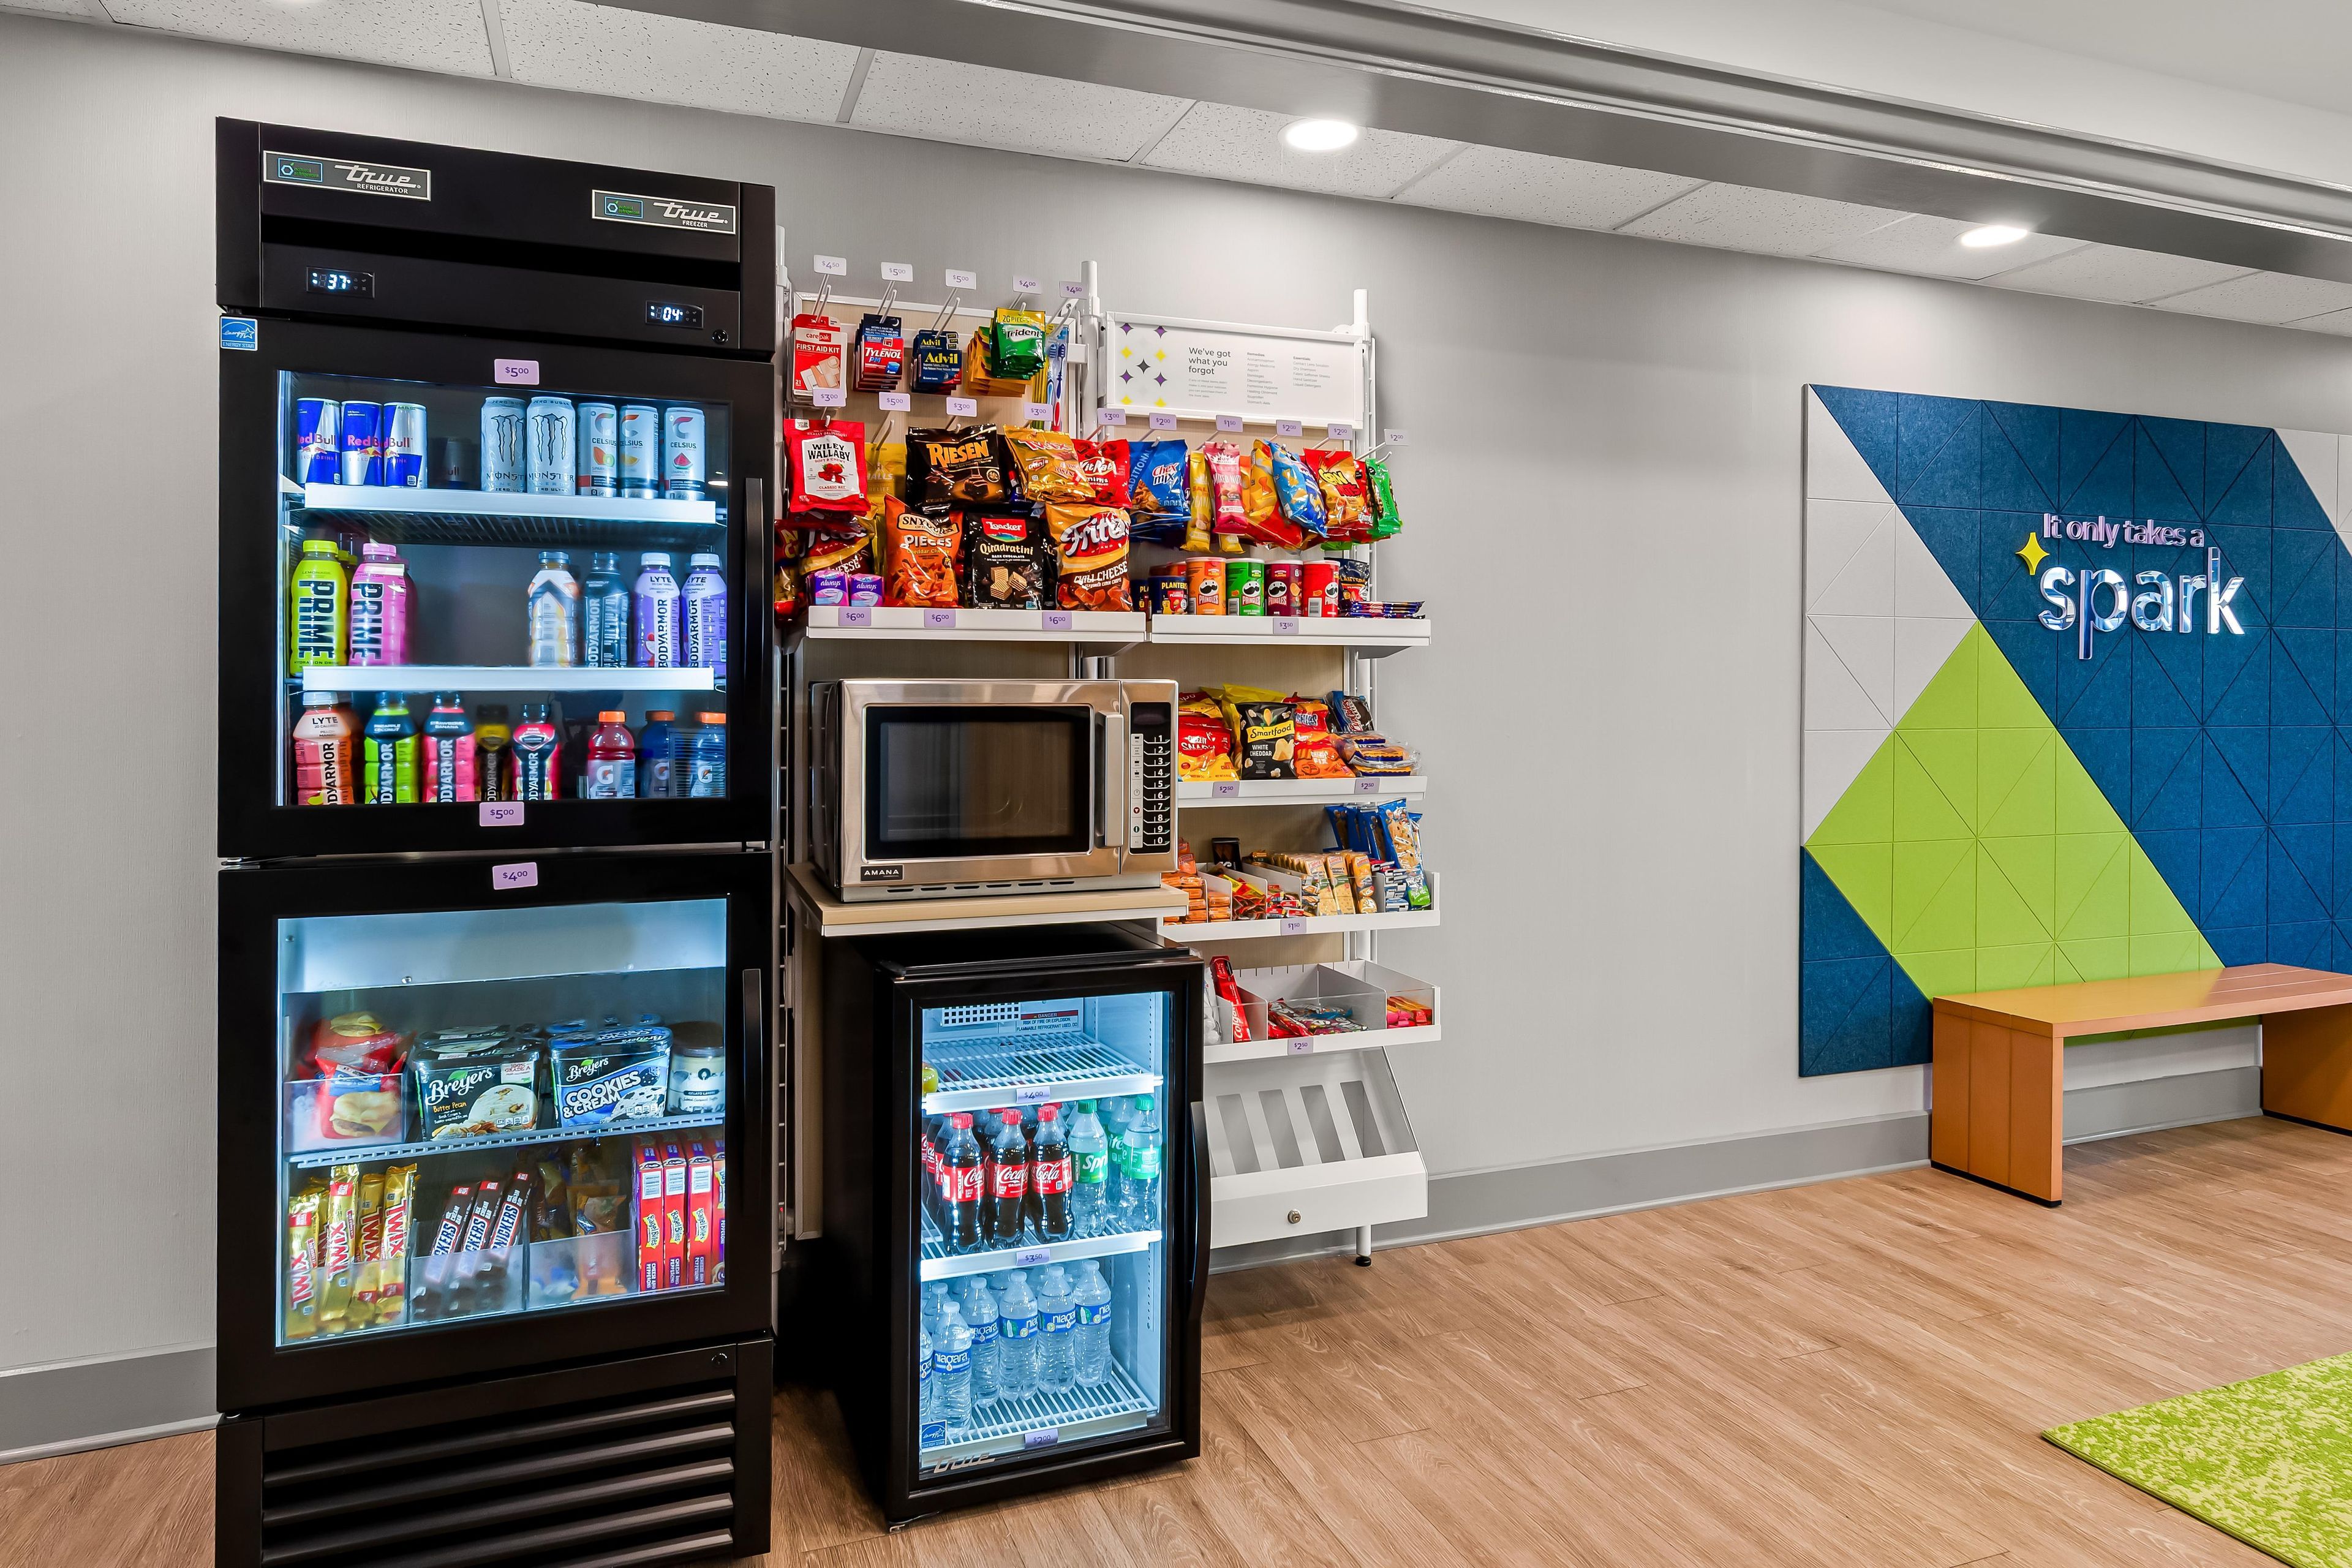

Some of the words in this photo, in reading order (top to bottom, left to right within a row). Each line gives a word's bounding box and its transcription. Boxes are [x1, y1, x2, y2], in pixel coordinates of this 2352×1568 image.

[334, 165, 418, 189] true
[356, 183, 409, 194] REFRIGERATOR
[653, 202, 724, 224] true
[1006, 329, 1040, 338] Trident
[865, 347, 902, 359] TYLENOL
[925, 352, 958, 364] Advil
[1188, 347, 1215, 356] We've
[1188, 366, 1215, 375] forgot
[315, 434, 336, 446] Bull
[347, 434, 371, 447] Red
[388, 437, 410, 448] Bull
[592, 437, 617, 447] CELSIUS
[812, 443, 845, 451] WILEY
[807, 450, 851, 462] WALLABY
[926, 440, 990, 468] RIESEN
[529, 470, 575, 483] MONSTR
[1152, 462, 1180, 477] Chex
[1318, 467, 1349, 486] CORN
[1153, 472, 1176, 486] mix
[986, 521, 1022, 531] Loacker
[2043, 513, 2062, 539] It
[2066, 515, 2120, 549] only
[2122, 519, 2187, 546] takes
[2188, 529, 2205, 548] a
[904, 534, 952, 548] PIECES
[980, 543, 1034, 556] Quadratini
[1097, 560, 1128, 581] CHEESE
[820, 579, 842, 588] always
[1199, 594, 1219, 605] PRINGLES
[1242, 594, 1261, 606] PRINGLES
[1268, 596, 1287, 606] PRINGLES
[2038, 546, 2245, 660] spark
[298, 579, 336, 659] PRIME
[352, 582, 384, 660] PRIME
[1250, 724, 1292, 738] Smartfood
[566, 1057, 609, 1082] Breyers
[424, 1068, 493, 1106] Breyers
[565, 1071, 642, 1107] COOKIES
[433, 1104, 451, 1113] Butter
[562, 1105, 575, 1119] &
[573, 1090, 621, 1115] CREAM
[1036, 1162, 1061, 1180] Cola
[385, 1198, 407, 1257] TWIX
[327, 1220, 350, 1282] TWIX
[935, 1351, 968, 1367] niagara
